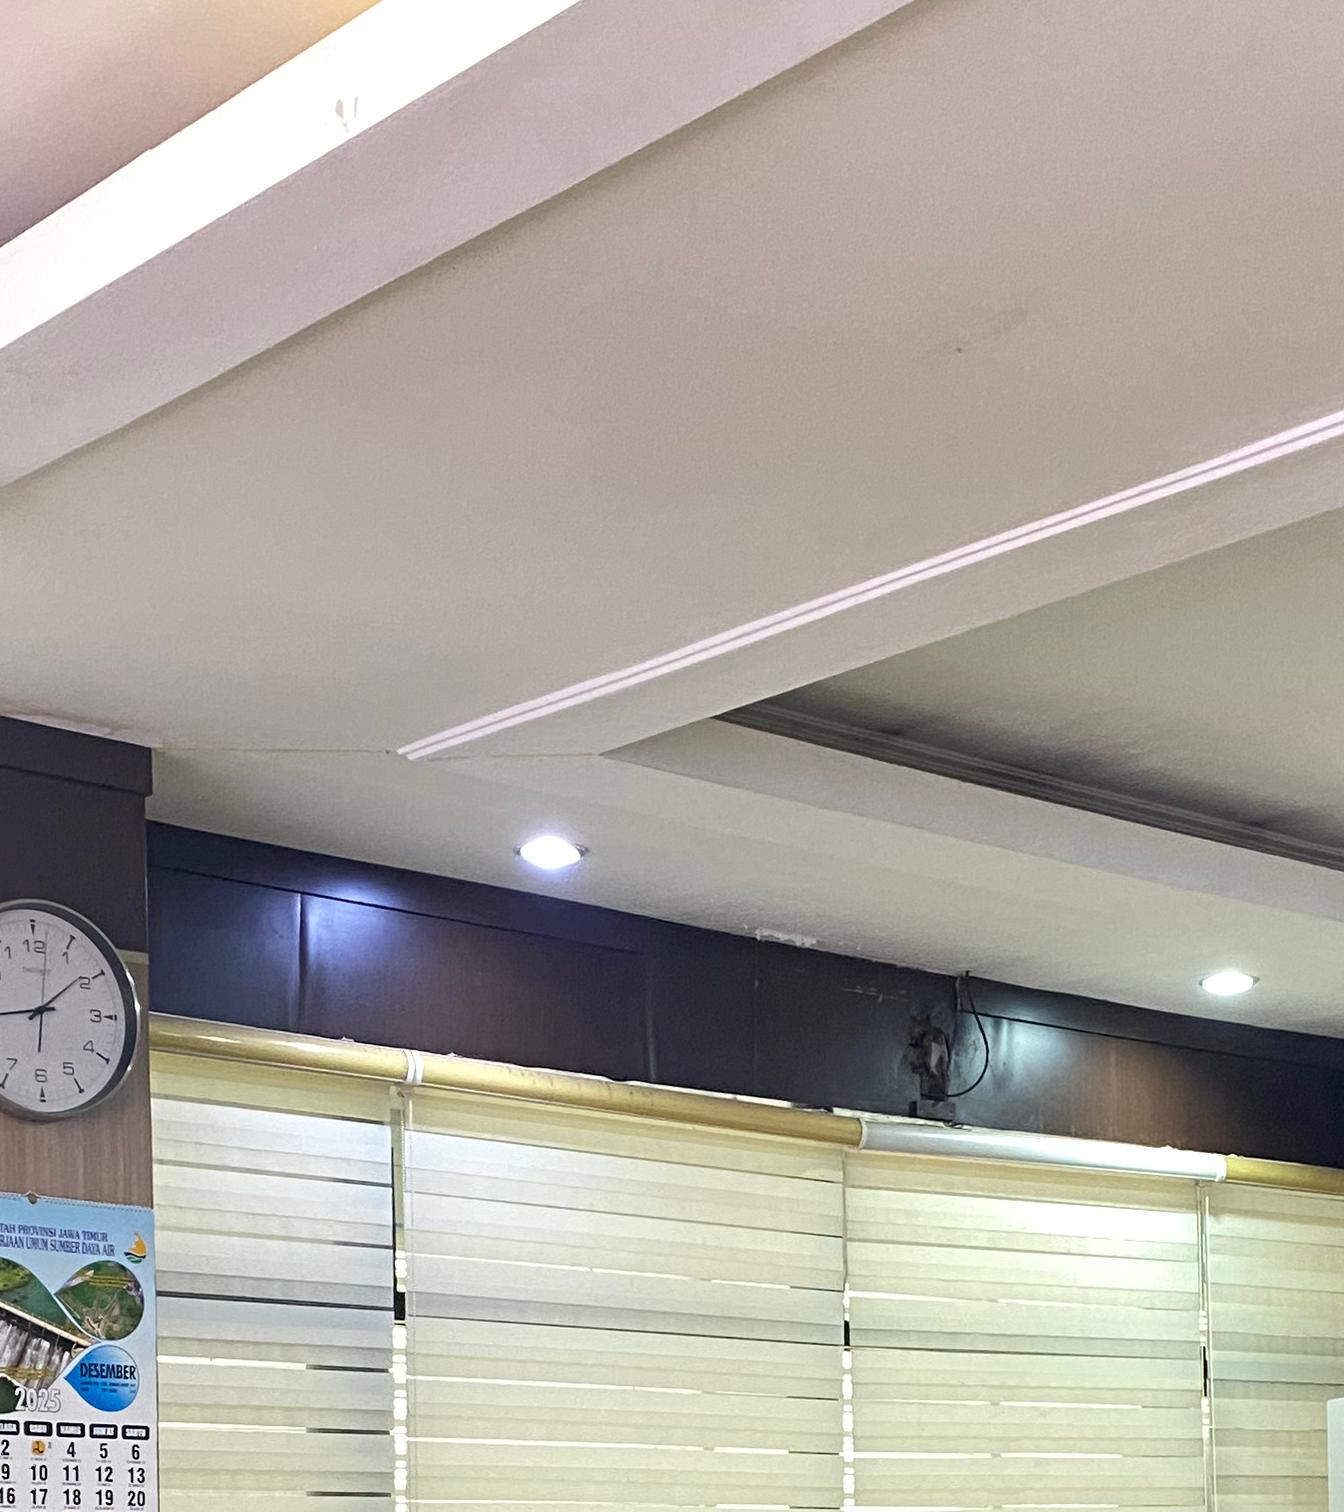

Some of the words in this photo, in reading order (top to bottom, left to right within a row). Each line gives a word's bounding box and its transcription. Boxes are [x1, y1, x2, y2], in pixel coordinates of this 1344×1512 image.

[23, 939, 46, 953] 12
[62, 951, 69, 964] 1
[79, 976, 91, 989] 2
[89, 1009, 102, 1023] 3
[83, 1040, 94, 1052] 4
[6, 1057, 18, 1069] 7
[63, 1062, 74, 1075] 5
[35, 1069, 47, 1083] 6
[18, 1224, 56, 1238] PROVINSI
[58, 1228, 80, 1240] JAWA
[82, 1230, 109, 1242] TIMUR
[50, 1239, 81, 1254] SUMBER
[79, 1362, 136, 1380] DESEMBER
[14, 1388, 61, 1412] 2025
[0, 1439, 10, 1456] 2
[67, 1442, 76, 1458] 4
[99, 1443, 108, 1459] 5
[131, 1444, 140, 1460] 6
[1, 1463, 10, 1480] 9
[30, 1464, 48, 1481] 10
[62, 1465, 79, 1481] 11
[95, 1466, 113, 1482] 12
[128, 1467, 145, 1484] 13
[29, 1488, 48, 1505] 17
[63, 1489, 81, 1505] 18
[95, 1489, 114, 1506] 19
[127, 1490, 145, 1507] 20
